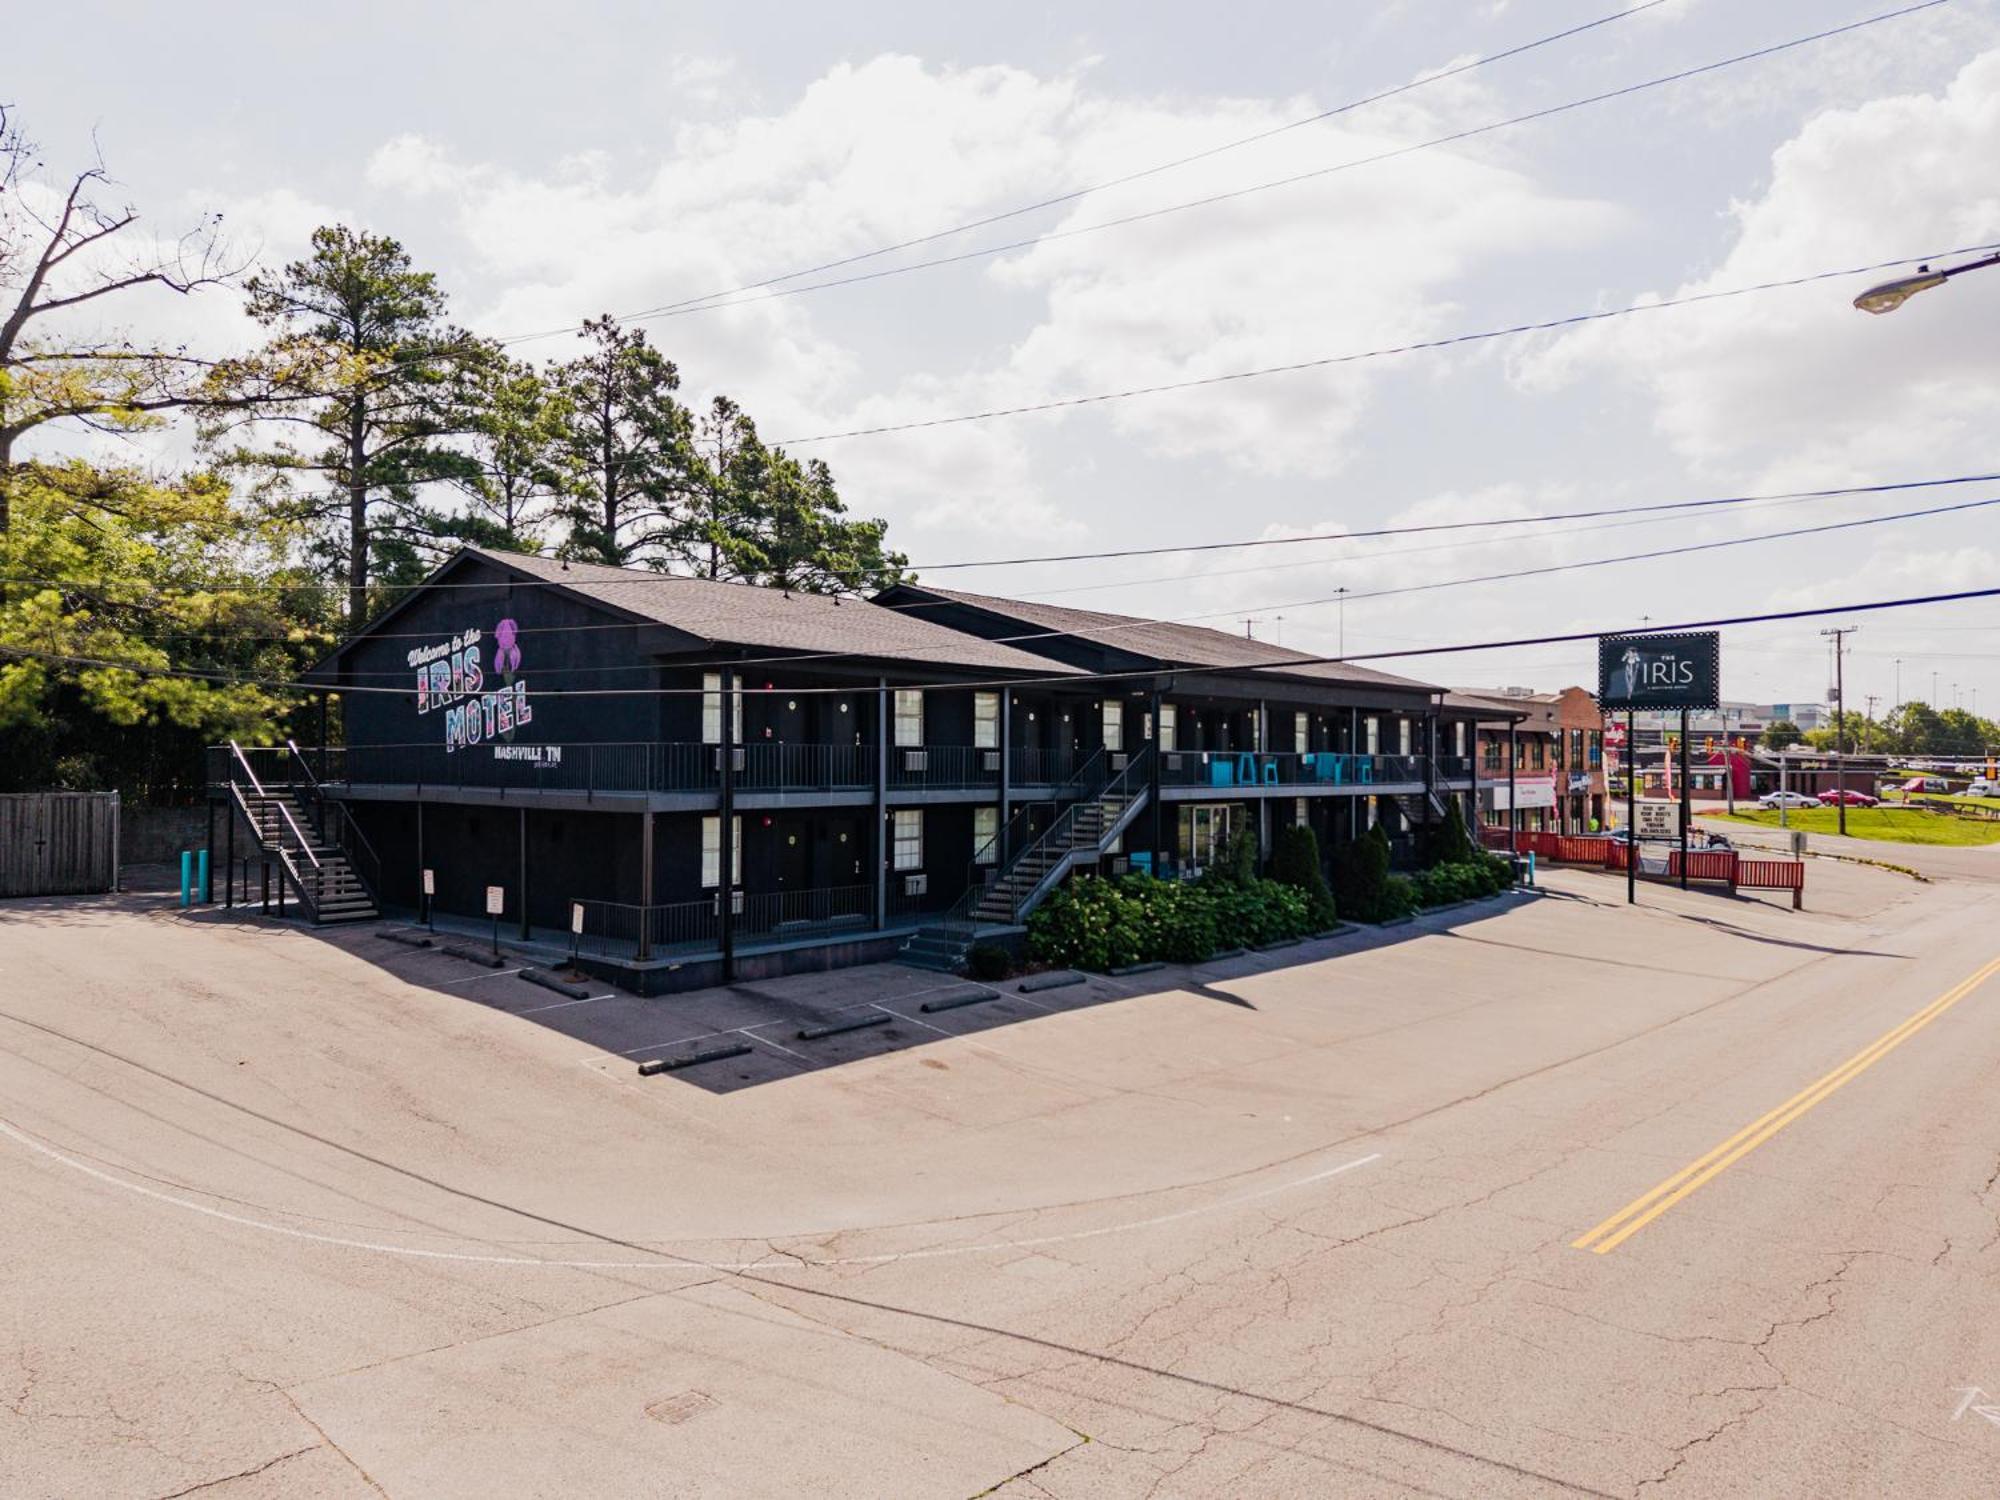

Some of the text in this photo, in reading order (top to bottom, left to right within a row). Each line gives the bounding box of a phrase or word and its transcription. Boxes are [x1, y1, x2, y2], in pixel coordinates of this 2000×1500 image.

[407, 628, 482, 668] Welcome to the
[417, 645, 484, 715] IRIS
[1643, 660, 1693, 684] IRIS
[445, 680, 533, 753] MOTEL
[494, 746, 561, 762] NASHVILLE TN
